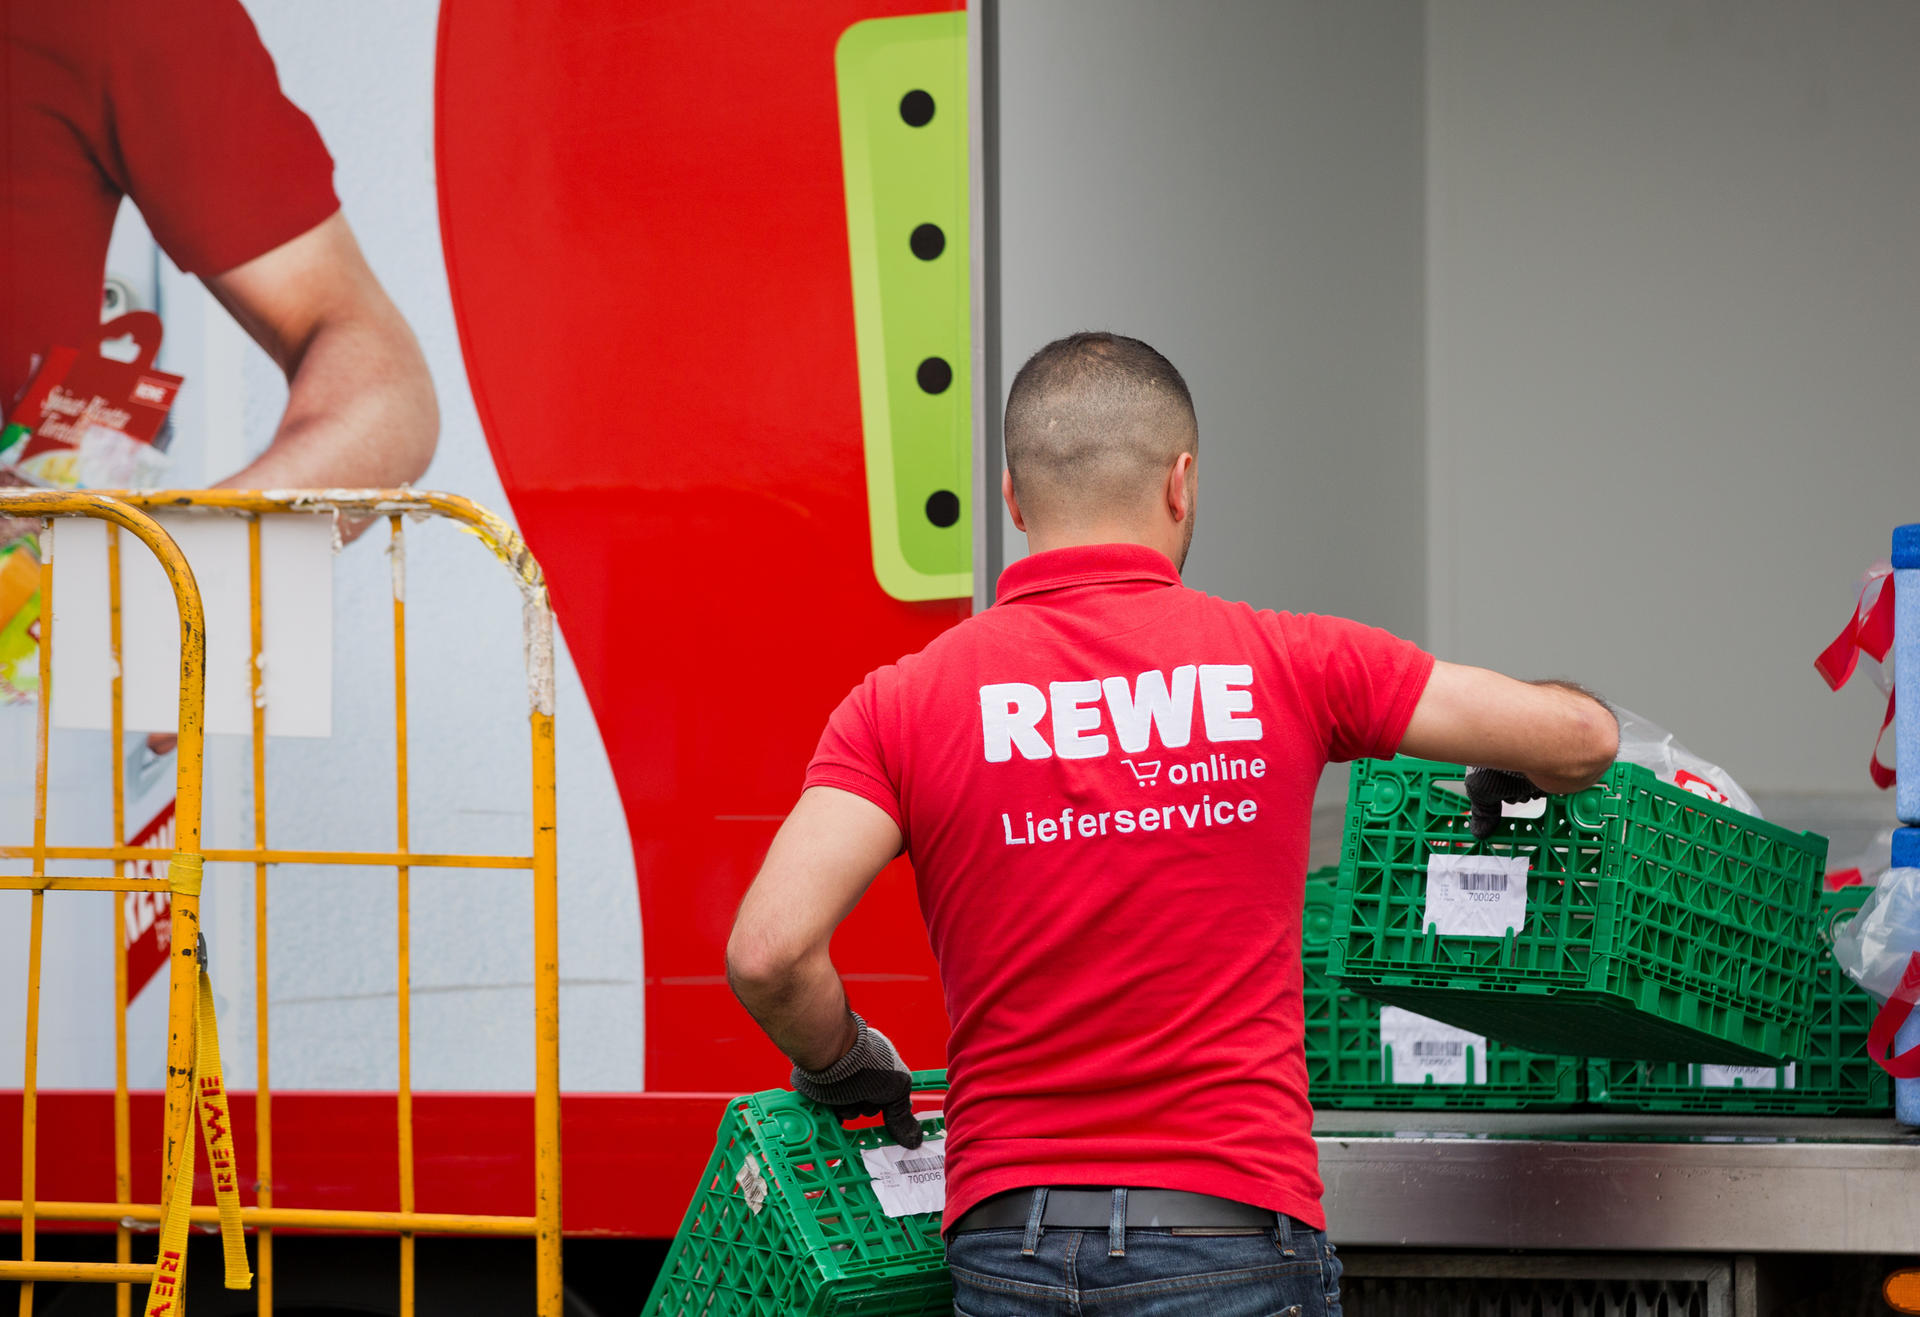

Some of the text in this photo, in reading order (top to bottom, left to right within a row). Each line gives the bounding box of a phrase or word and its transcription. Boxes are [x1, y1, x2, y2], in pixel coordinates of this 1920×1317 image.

[979, 664, 1263, 763] REWE
[1168, 753, 1267, 785] online
[1002, 795, 1258, 845] Lieferservice
[1468, 892, 1501, 903] 700029
[200, 1075, 233, 1192] REWE
[907, 1171, 942, 1184] 700006
